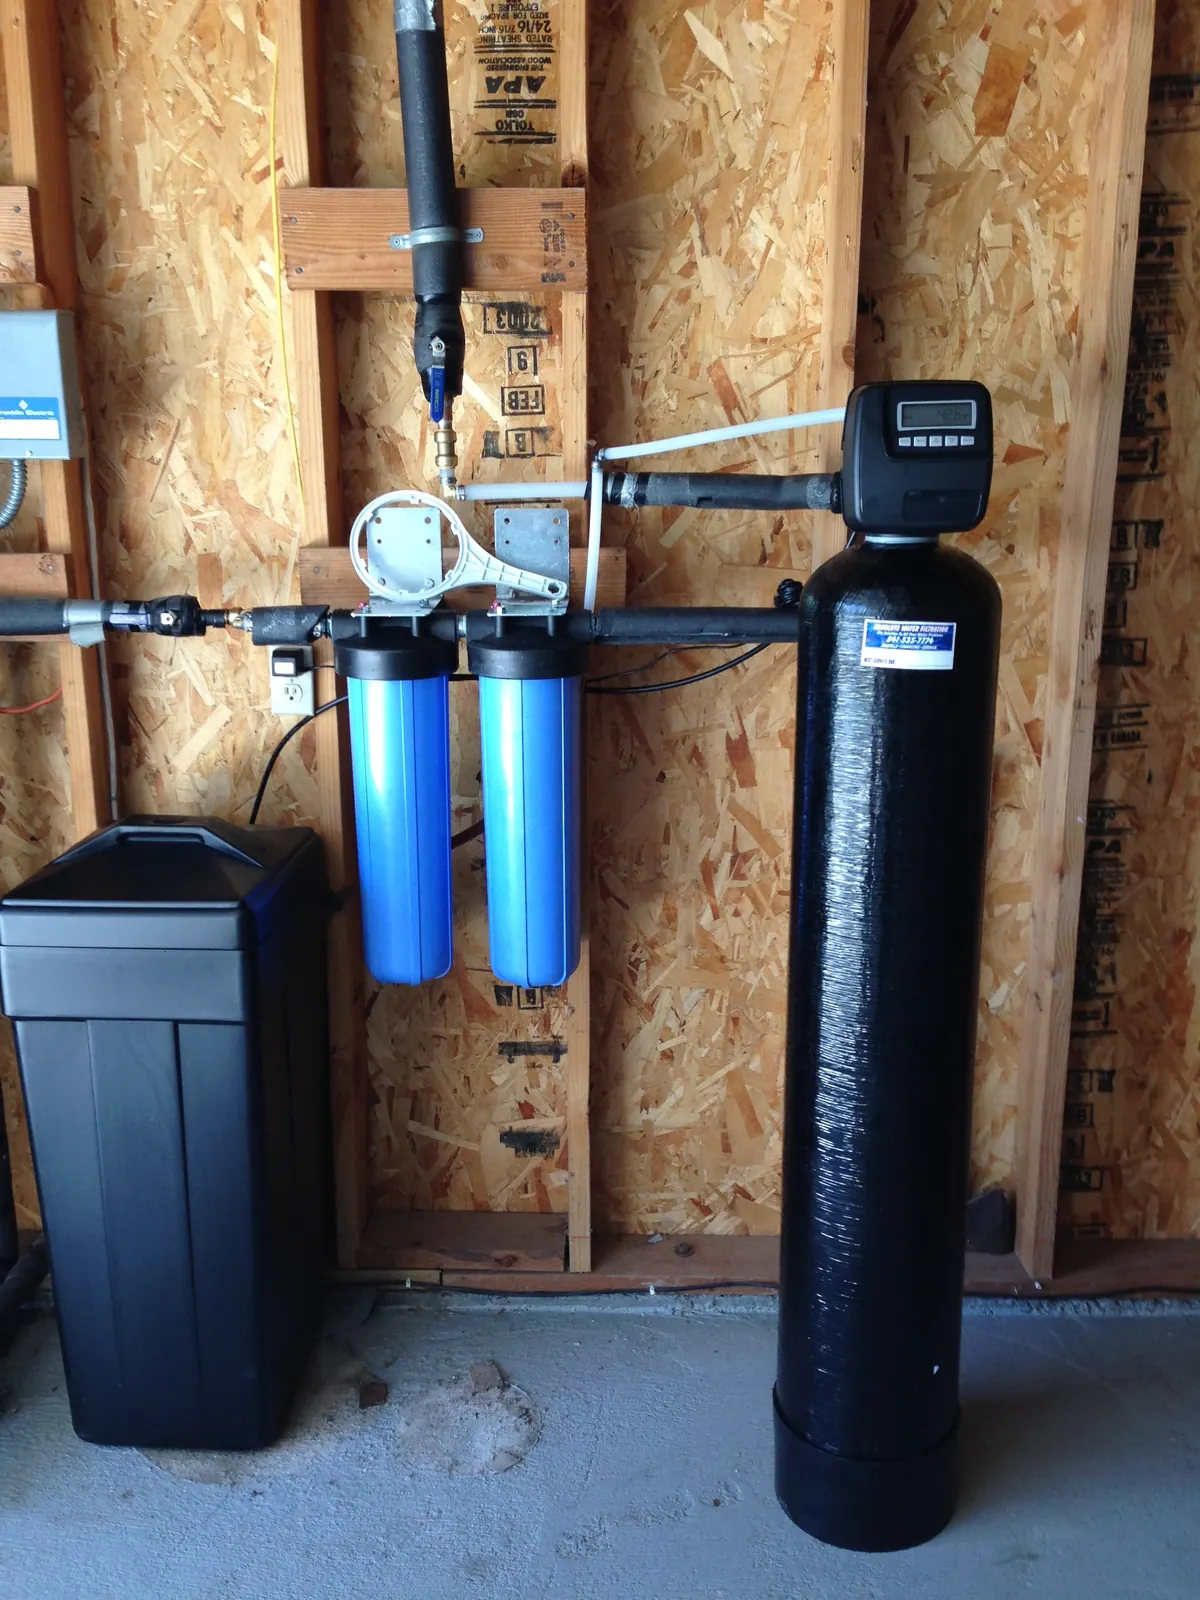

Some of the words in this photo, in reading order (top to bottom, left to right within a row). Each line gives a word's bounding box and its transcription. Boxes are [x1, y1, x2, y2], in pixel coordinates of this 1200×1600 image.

[499, 3, 538, 11] EXPOSURE
[518, 20, 551, 33] 24/16
[485, 76, 546, 94] APA
[496, 120, 534, 131] TOLKO
[496, 307, 541, 329] 2003
[518, 351, 528, 371] 9
[508, 390, 540, 410] FEB
[515, 433, 526, 452] B
